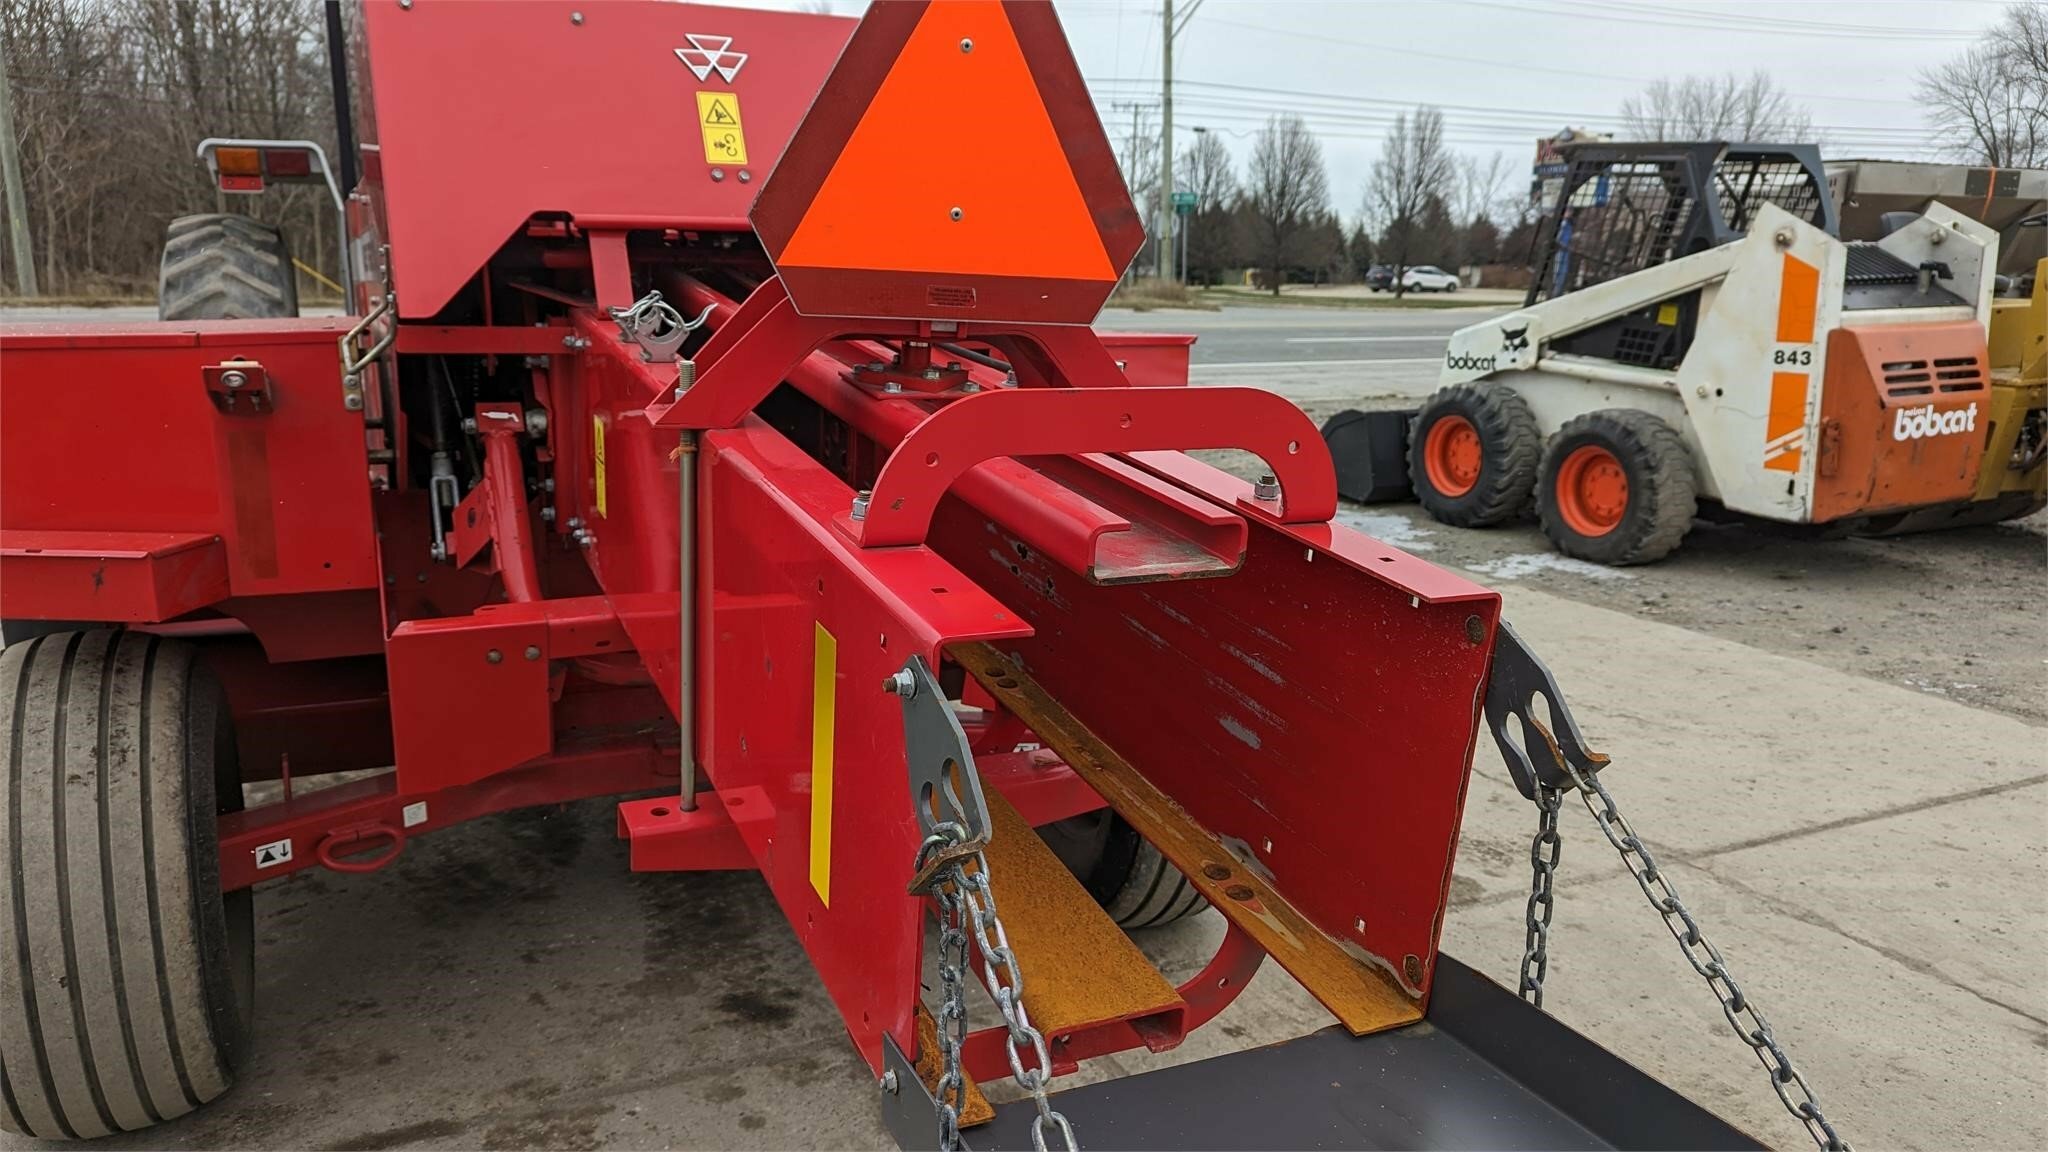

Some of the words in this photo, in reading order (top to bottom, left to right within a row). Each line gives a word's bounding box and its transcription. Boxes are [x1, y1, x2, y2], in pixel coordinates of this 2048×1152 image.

[1447, 350, 1496, 372] bobcat
[1774, 350, 1811, 366] 843
[1894, 402, 1978, 441] bobcat
